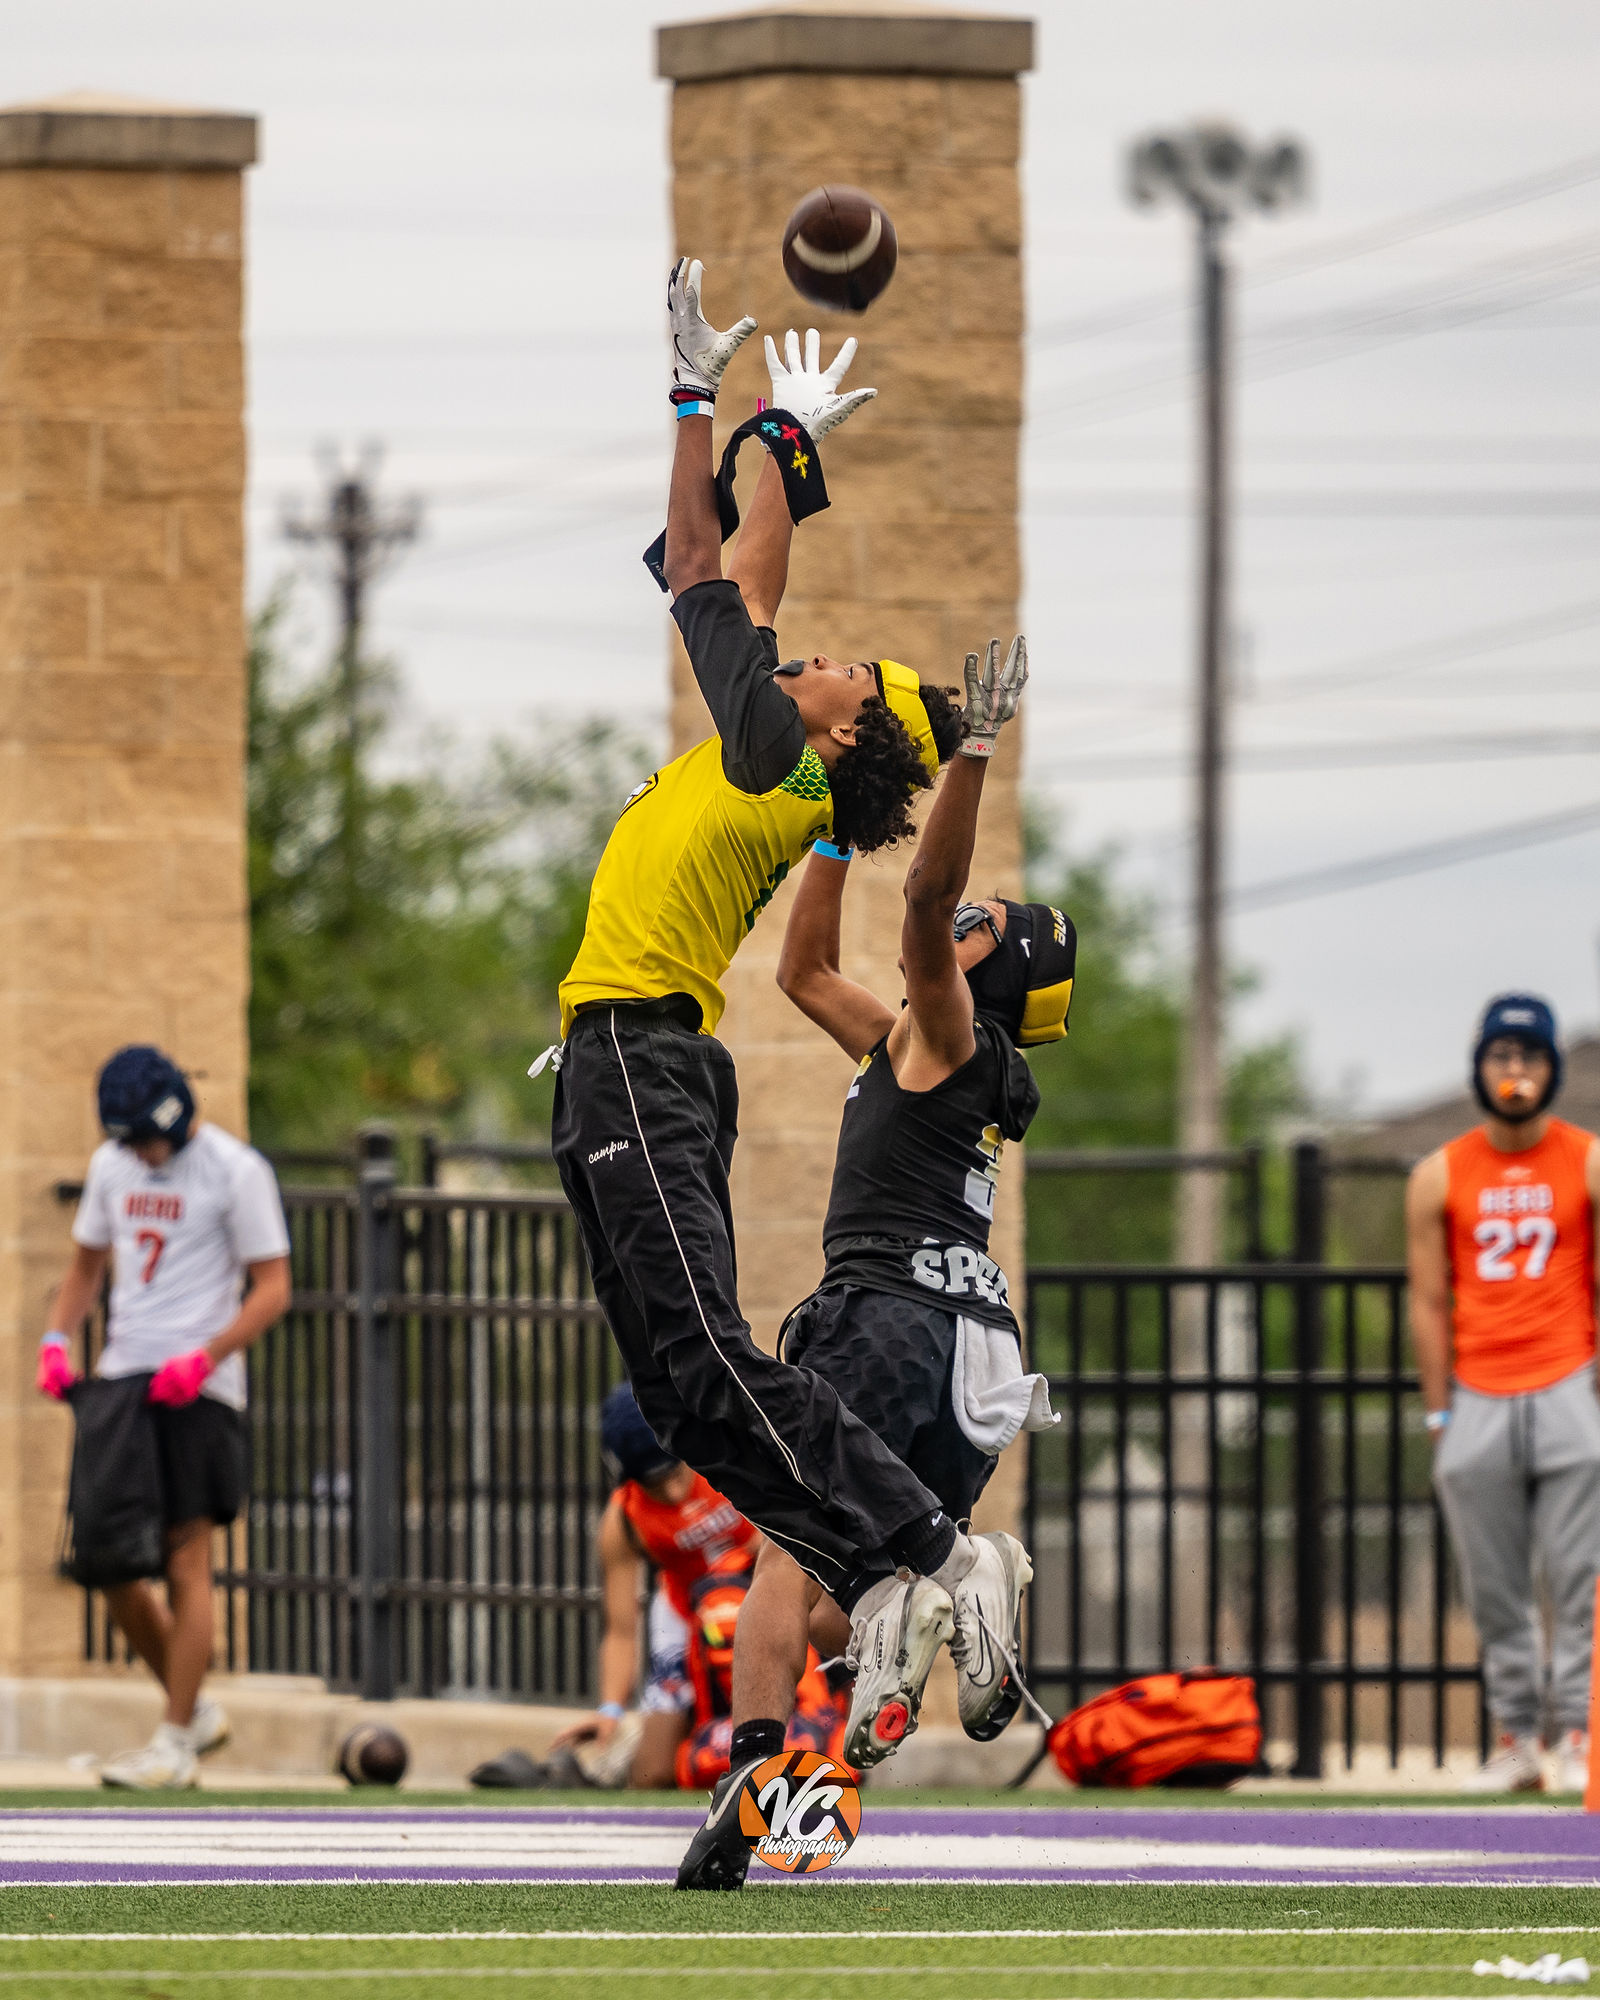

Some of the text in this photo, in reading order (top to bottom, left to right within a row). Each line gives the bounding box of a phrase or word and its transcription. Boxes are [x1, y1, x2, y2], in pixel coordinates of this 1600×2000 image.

[588, 1139, 629, 1164] campus
[135, 1228, 167, 1284] 7
[1473, 1216, 1557, 1281] 27
